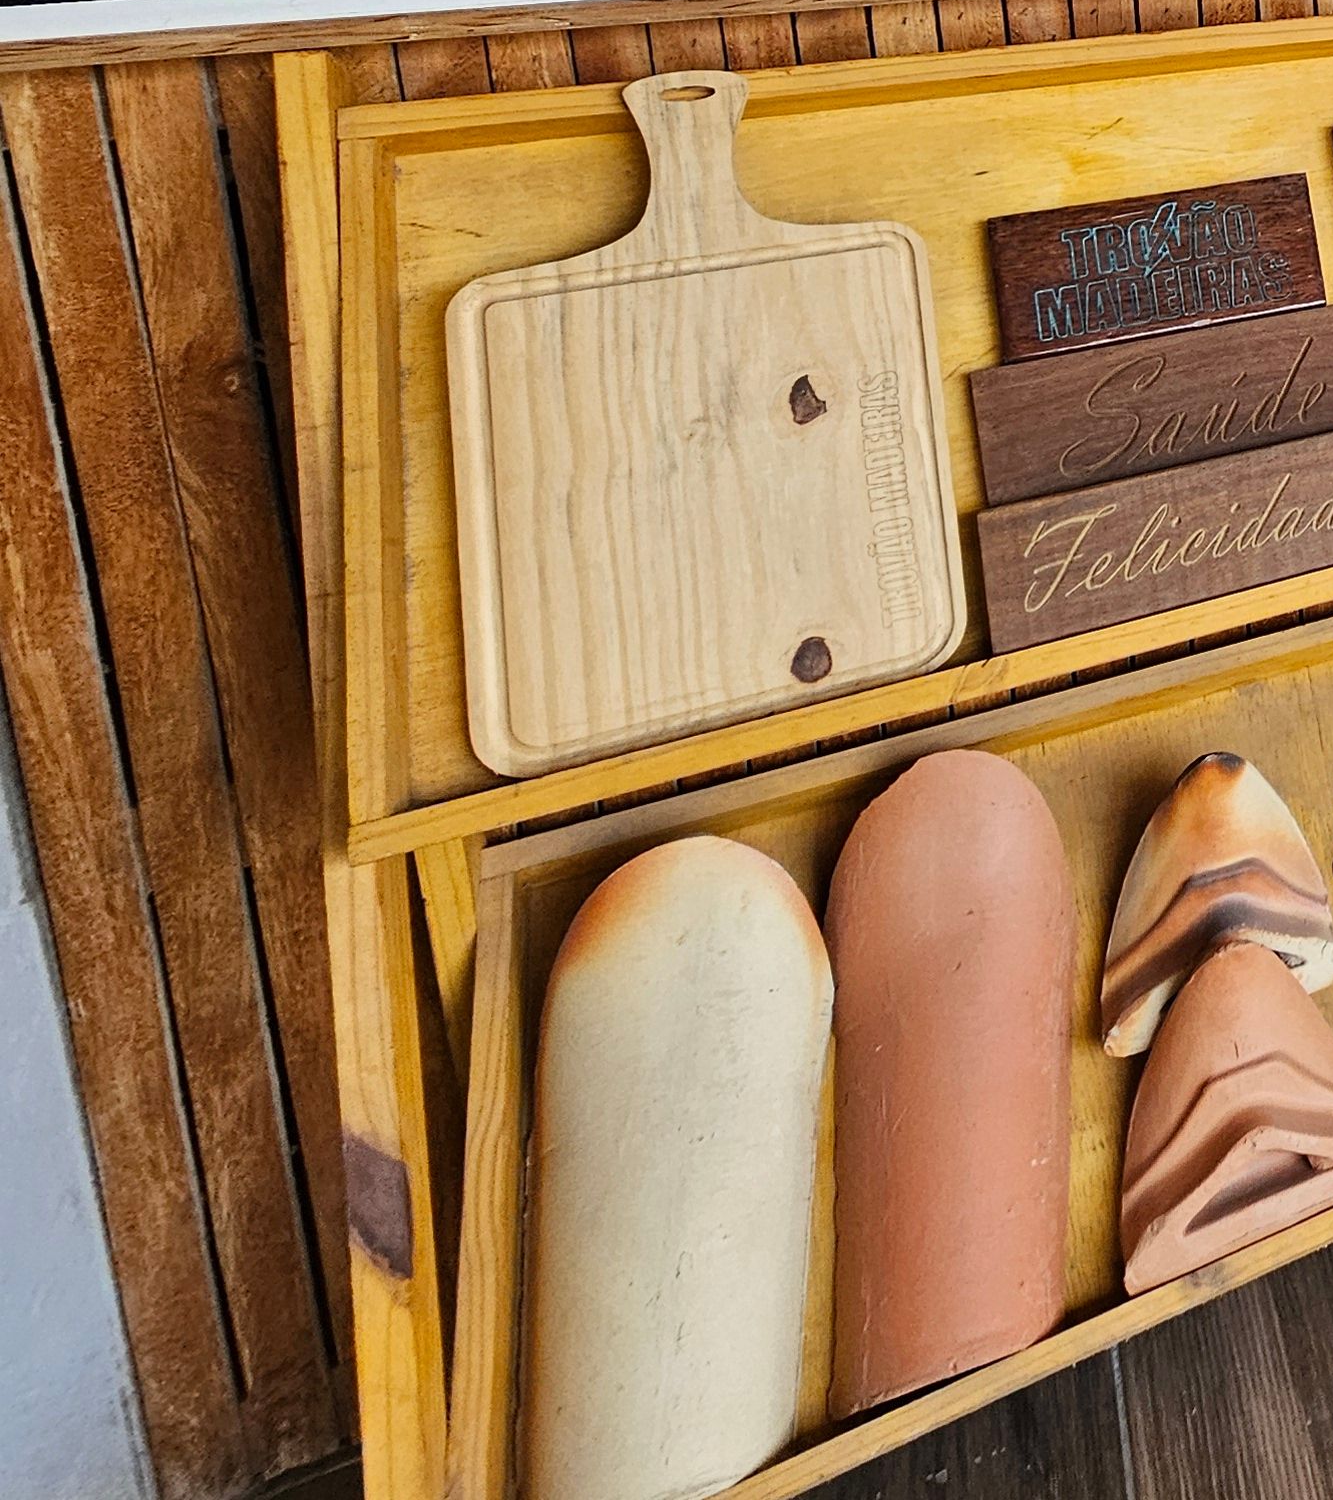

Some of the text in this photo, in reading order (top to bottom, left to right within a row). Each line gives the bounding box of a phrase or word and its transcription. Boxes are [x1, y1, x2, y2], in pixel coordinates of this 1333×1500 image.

[1034, 252, 1293, 342] MADEIRAS
[1061, 200, 1257, 280] TROVÃO
[857, 370, 910, 512] MADEIRAS
[1060, 336, 1327, 477] Saúde
